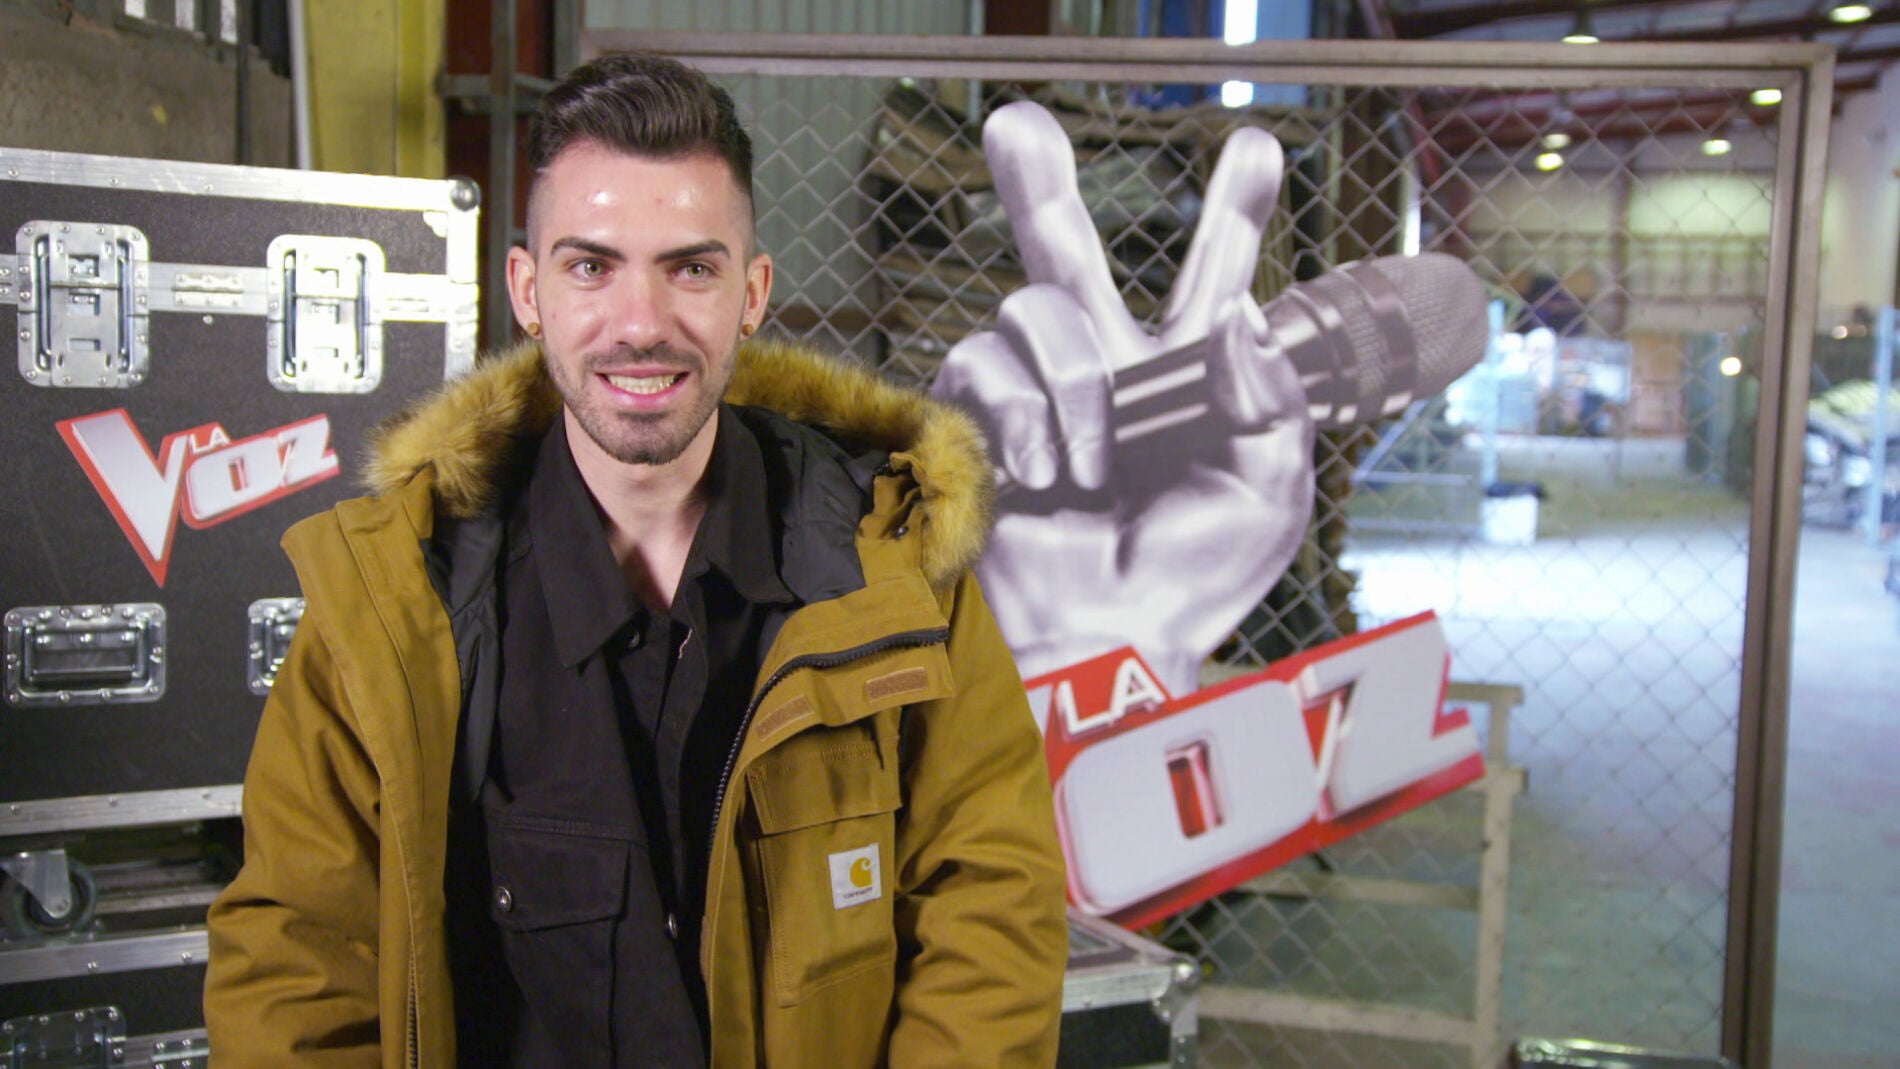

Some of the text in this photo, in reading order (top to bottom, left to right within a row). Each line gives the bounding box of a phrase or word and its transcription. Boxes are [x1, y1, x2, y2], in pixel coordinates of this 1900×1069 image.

[190, 426, 231, 455] LA
[1027, 619, 1483, 916] LA OZ
